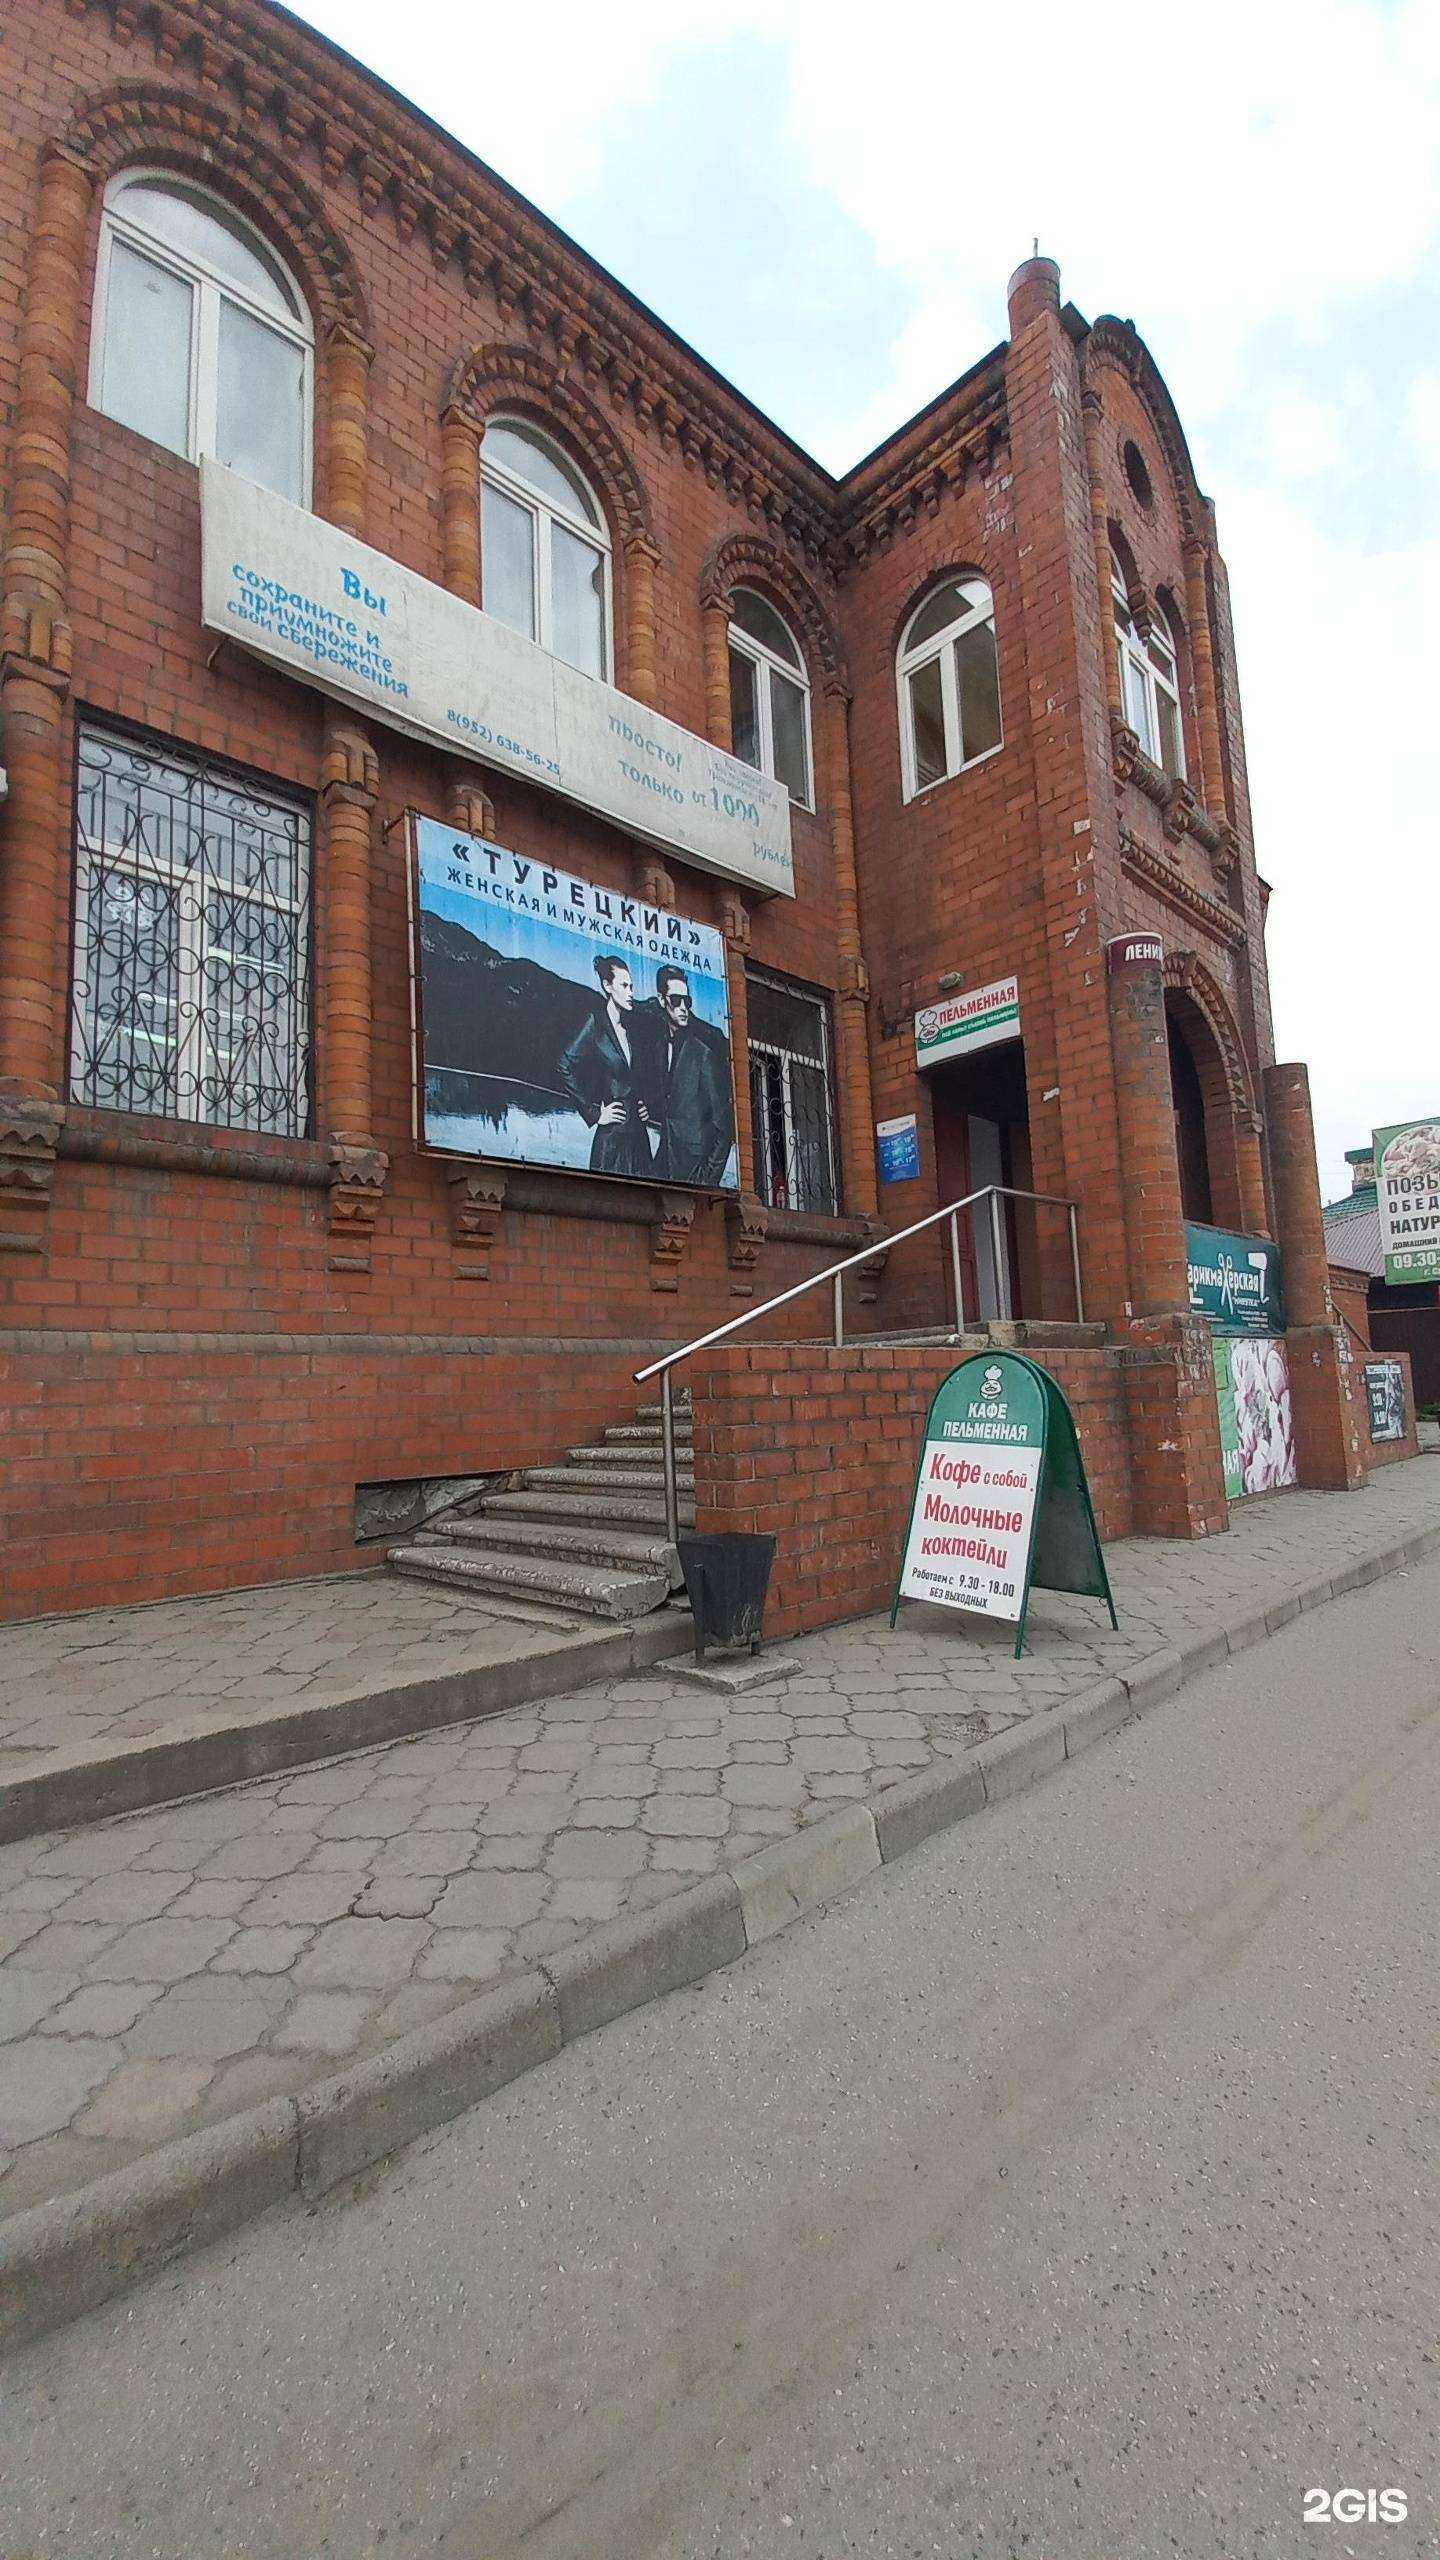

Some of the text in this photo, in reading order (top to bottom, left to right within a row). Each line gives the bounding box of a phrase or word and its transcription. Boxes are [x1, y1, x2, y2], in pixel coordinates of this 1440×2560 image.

[232, 563, 381, 650] сохраните и
[339, 566, 389, 617] Вы
[226, 601, 409, 698] свои сбережения
[240, 587, 393, 673] приумножите
[447, 709, 560, 775] 8(952) 638-56-25
[452, 843, 701, 946] «ТУРЕЦКИЙ»
[447, 866, 712, 971] ЖЕНСКАЯ И МУЖСКАЯ ОДЕЖДА
[1125, 943, 1162, 961] ЛЕНИ
[940, 986, 1015, 1025] ПЕЛЬМЕННАЯ
[1186, 1256, 1259, 1308] арикмахерская
[968, 1402, 1008, 1420] КАФЕ
[943, 1421, 1028, 1441] ПЕЛЬМЕННАЯ
[929, 1453, 1027, 1489] Кофе с собой
[923, 1494, 1023, 1533] Молочные
[921, 1536, 1007, 1569] коктейли
[912, 1567, 947, 1583] Работаем
[959, 1574, 979, 1590] 9.30
[988, 1579, 1015, 1597] 18.00
[929, 1587, 988, 1609] БЕЗ ВЫХОДНЫХ
